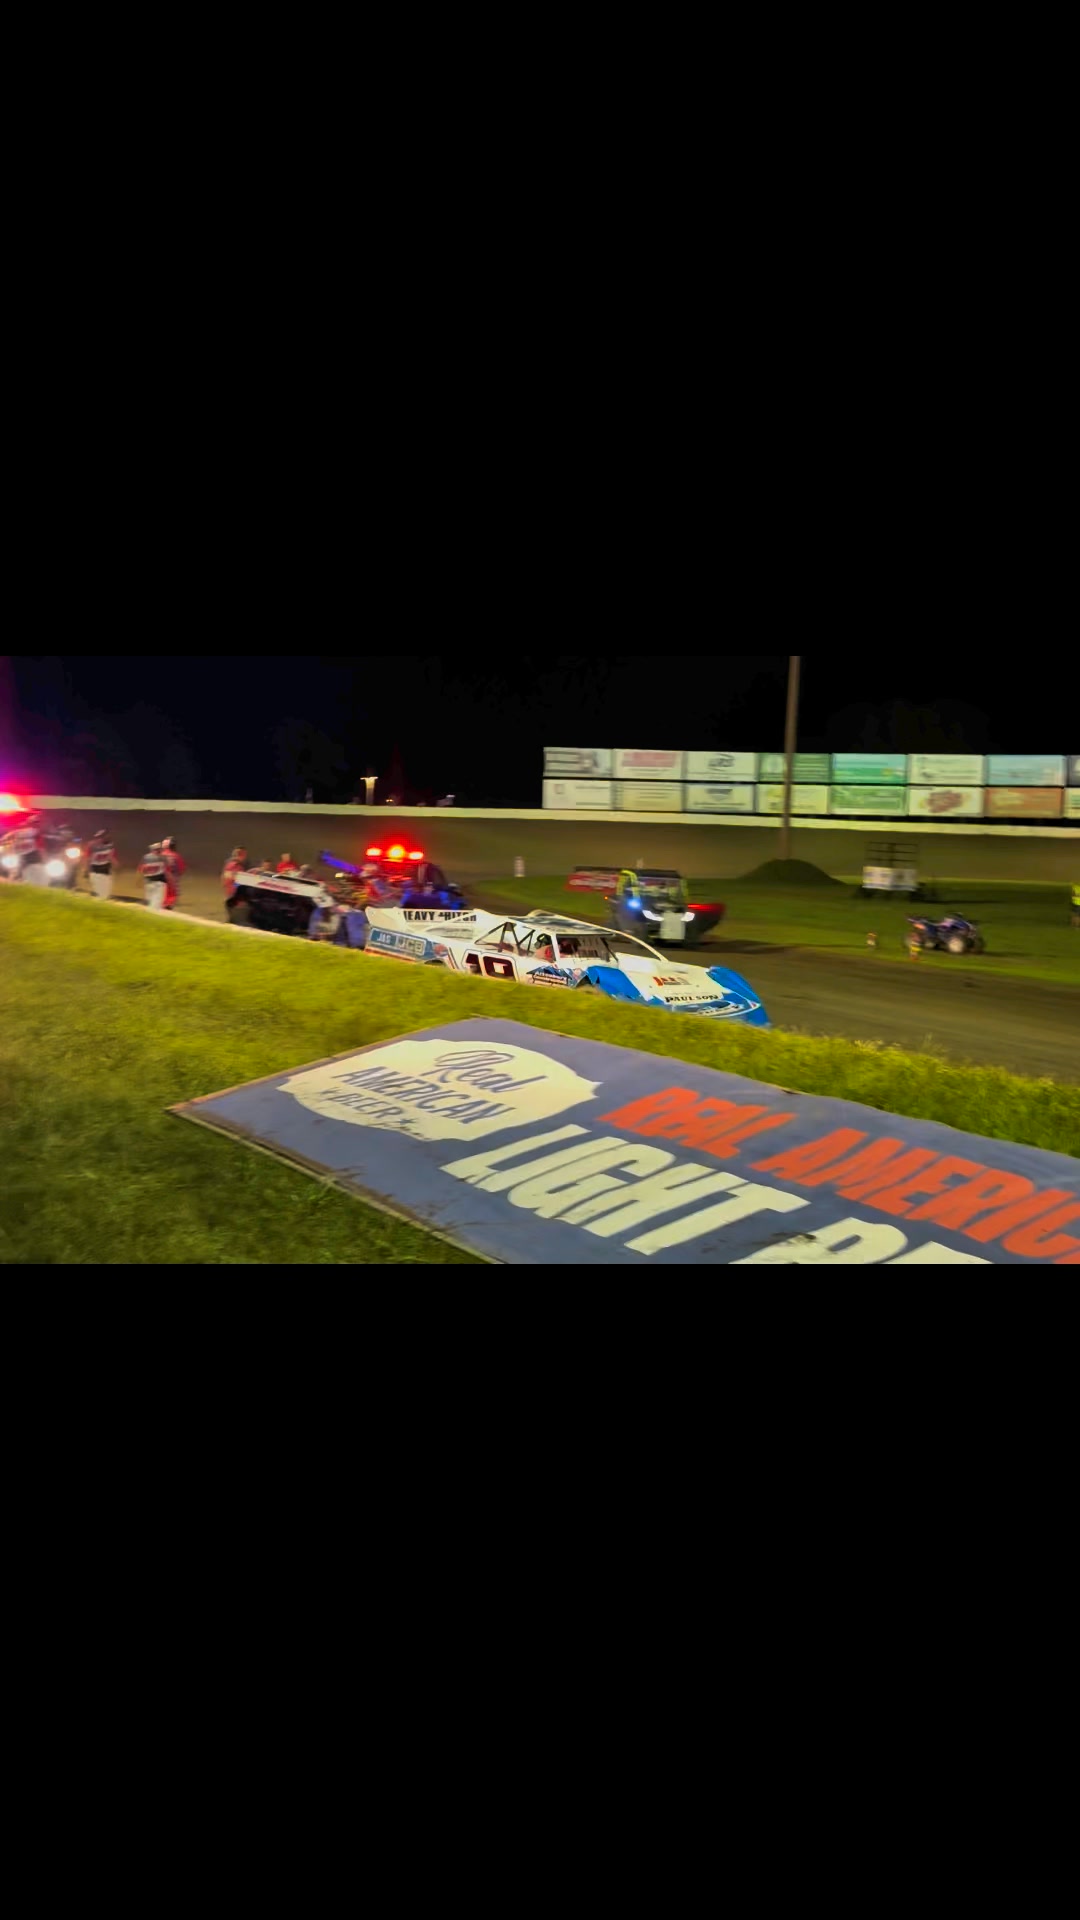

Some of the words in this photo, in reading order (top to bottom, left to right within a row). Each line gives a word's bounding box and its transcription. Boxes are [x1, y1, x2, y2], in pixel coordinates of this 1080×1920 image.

[331, 1066, 516, 1125] AMERICAN
[420, 1050, 547, 1093] Real
[327, 1092, 405, 1119] BEER
[439, 1123, 812, 1255] LIGHT
[596, 1086, 798, 1159] REAL
[748, 1127, 1080, 1264] AMERIC
